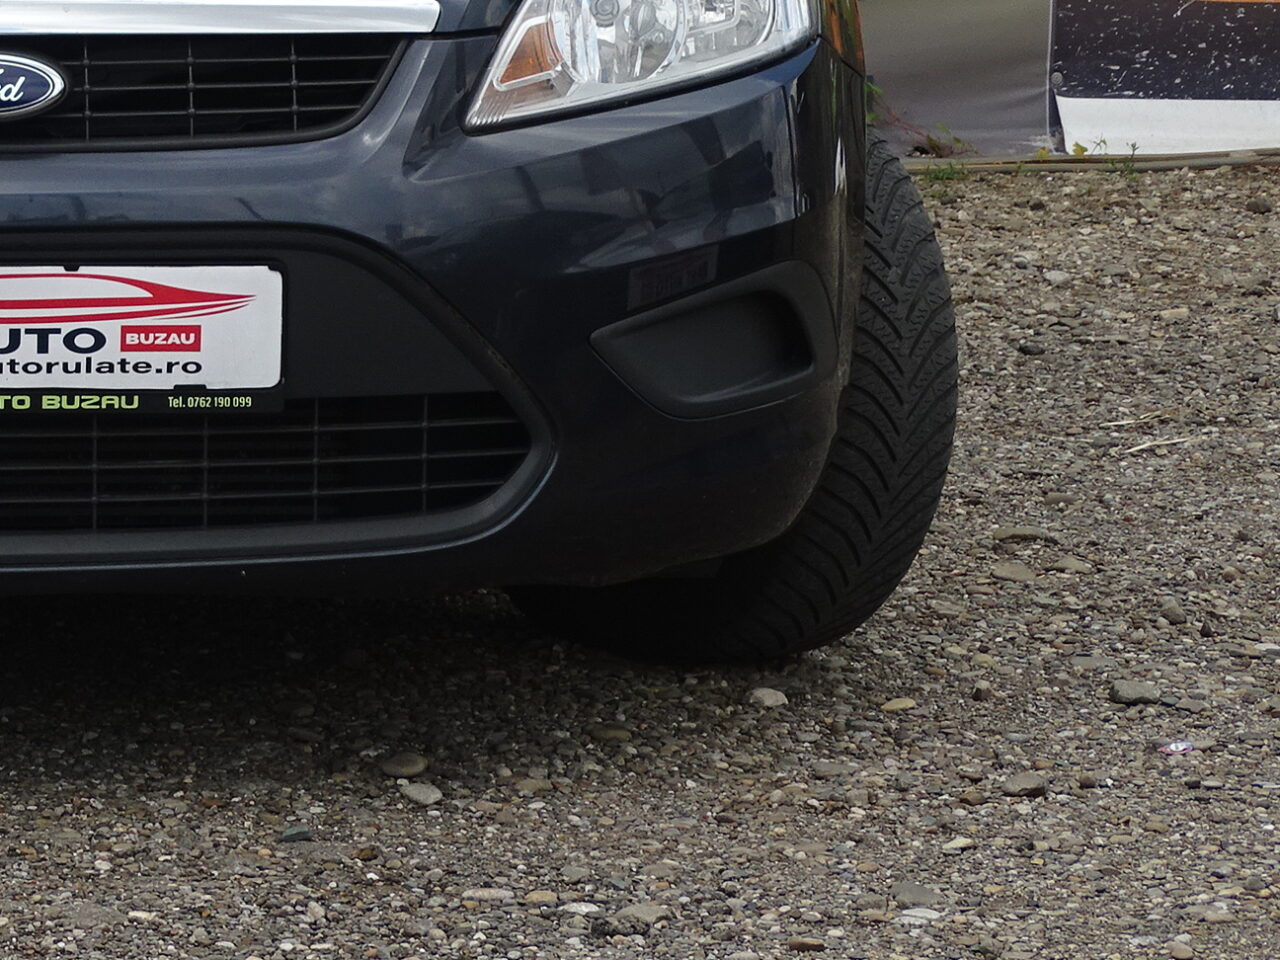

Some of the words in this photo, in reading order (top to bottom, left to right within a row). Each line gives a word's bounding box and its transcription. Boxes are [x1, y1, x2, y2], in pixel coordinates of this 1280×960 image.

[125, 332, 196, 346] BUZAU
[41, 394, 140, 410] BUZAU
[168, 396, 186, 408] Tel.
[187, 396, 212, 408] 0762
[214, 396, 231, 408] 190
[232, 396, 252, 408] 099
